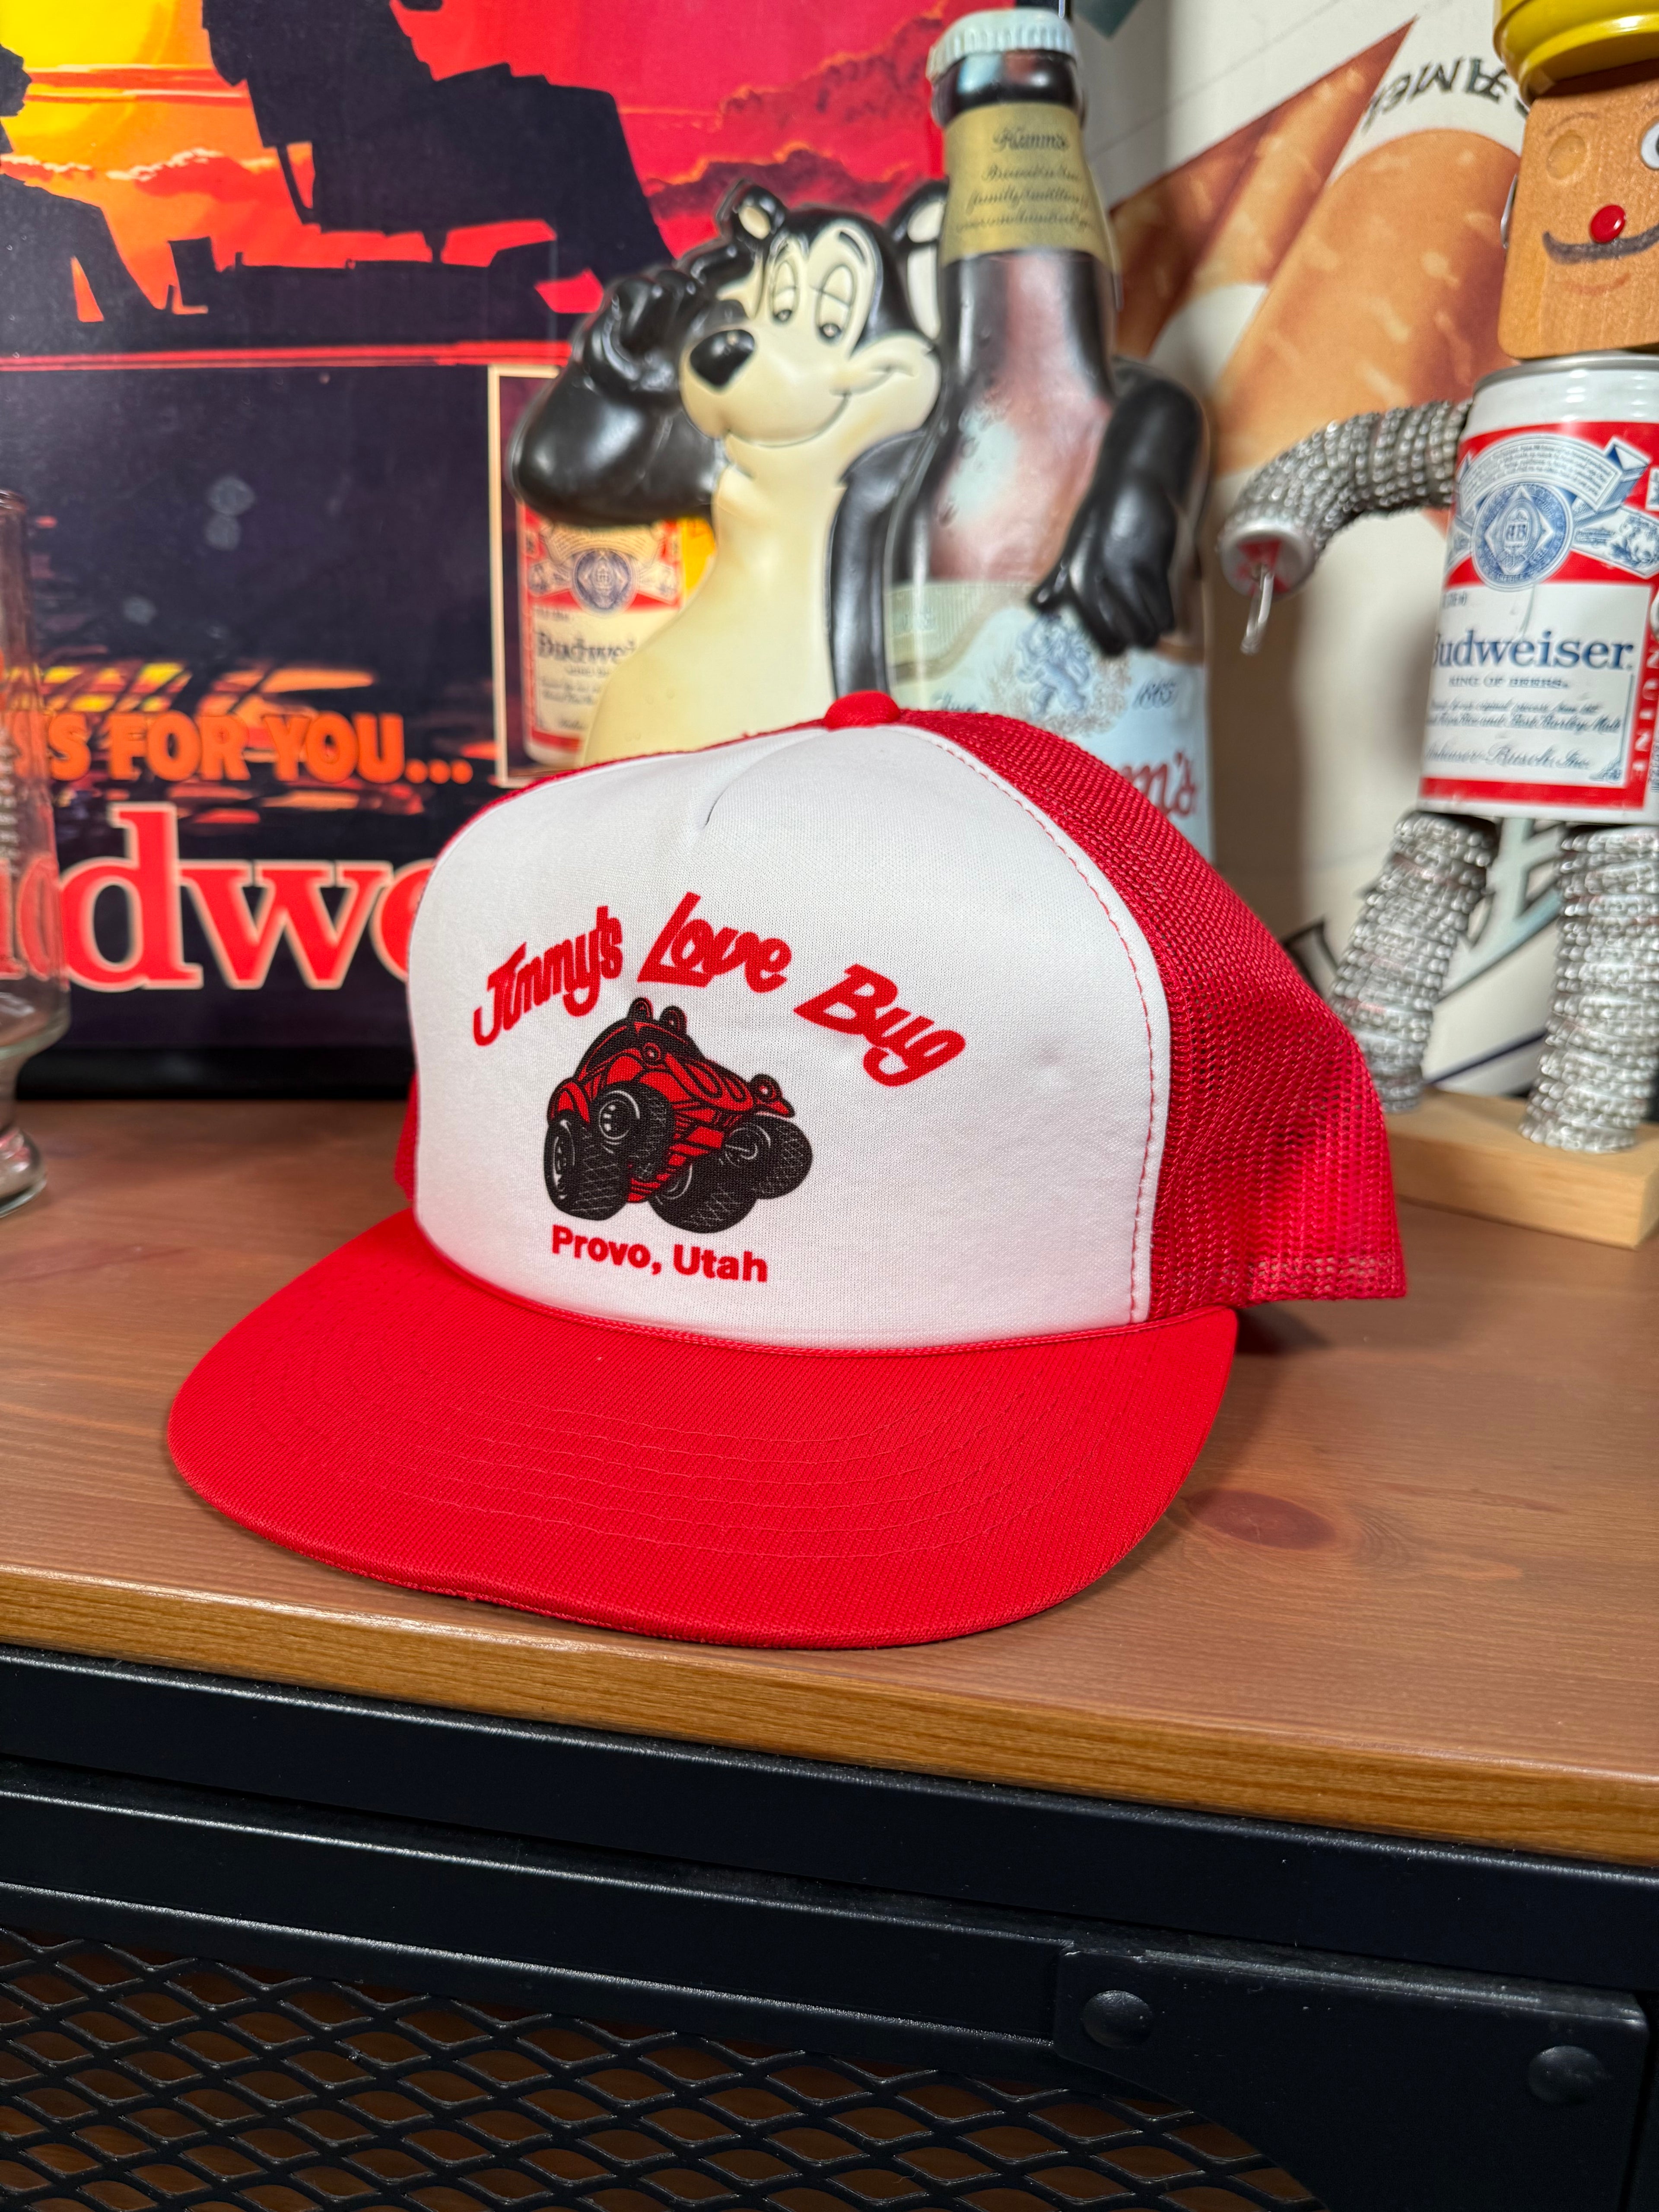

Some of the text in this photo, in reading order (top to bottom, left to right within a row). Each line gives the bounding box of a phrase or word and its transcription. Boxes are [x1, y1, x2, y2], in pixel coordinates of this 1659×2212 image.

[1433, 629, 1634, 671] udweiser.
[107, 711, 251, 782] FOR
[473, 891, 966, 1088] Jimmy's Love Bug
[551, 1224, 768, 1283] Provo, Utah
